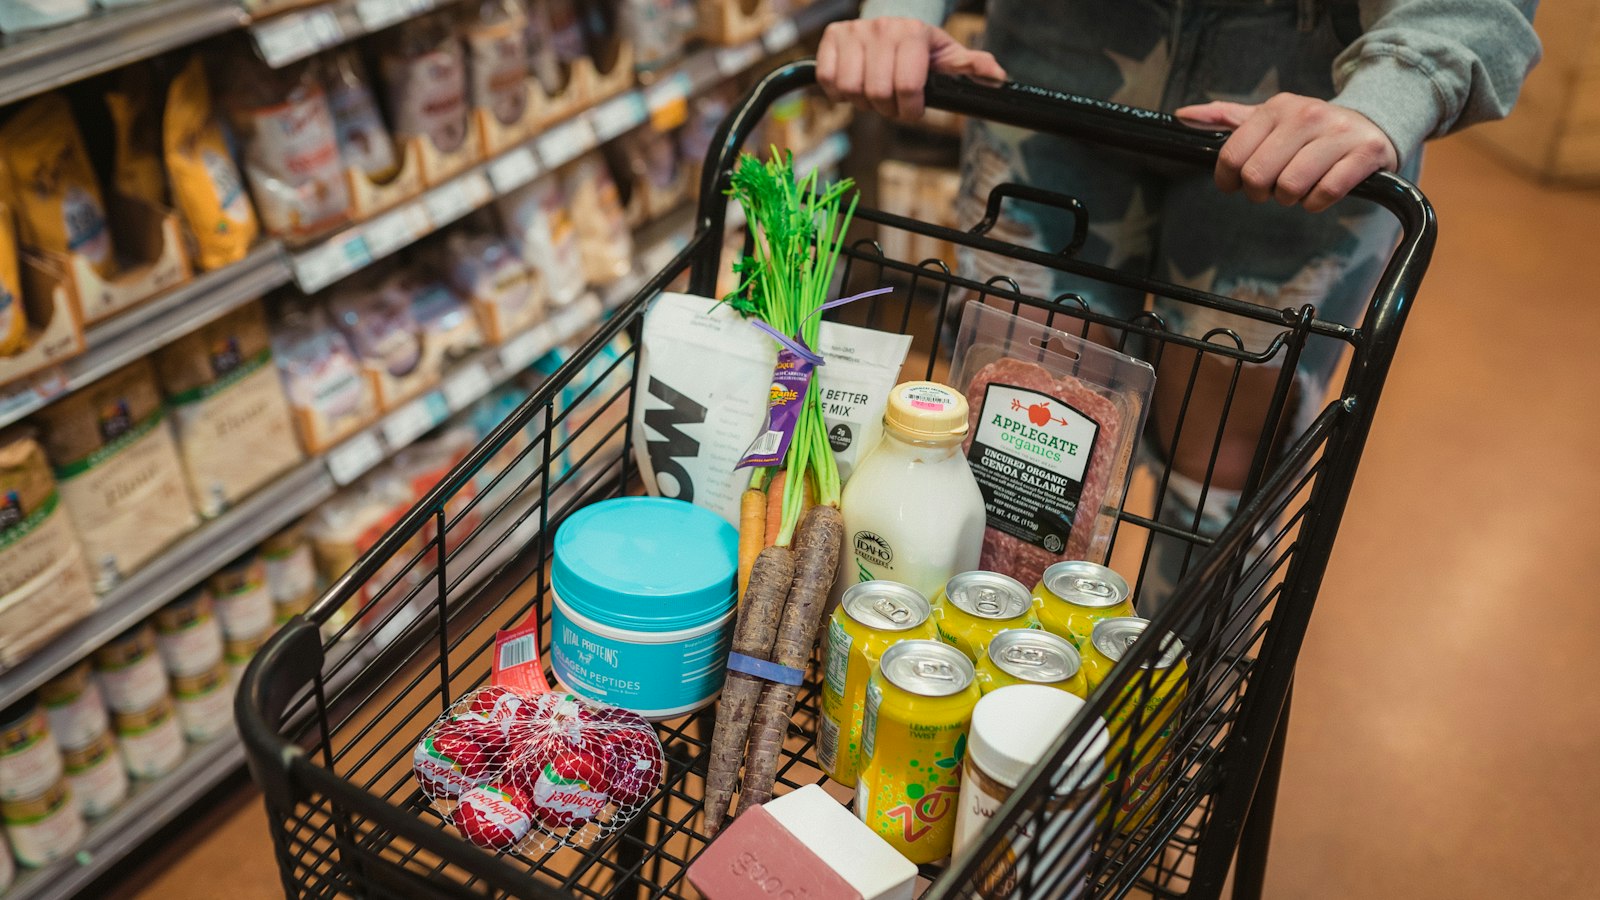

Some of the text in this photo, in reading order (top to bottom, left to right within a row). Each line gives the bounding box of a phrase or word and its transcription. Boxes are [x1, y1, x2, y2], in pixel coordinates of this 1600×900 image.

[826, 389, 869, 406] BETTER
[828, 404, 850, 417] MIX
[644, 376, 708, 500] OW
[836, 426, 846, 438] 2g
[992, 414, 1078, 456] APPLEGATE
[980, 456, 1066, 496] GENOA SALAMI
[984, 448, 1067, 486] UNCURED ORGANIC
[985, 503, 995, 511] NET
[856, 540, 890, 561] IDAHO
[562, 624, 579, 647] VITAL
[582, 638, 618, 669] PROTEINS
[554, 641, 587, 678] COLLAGEN
[590, 671, 640, 691] PEPTIDES
[909, 723, 941, 732] LEMON
[909, 730, 935, 739] TWIST
[467, 790, 522, 825] Babybel
[547, 790, 606, 816] Babybel
